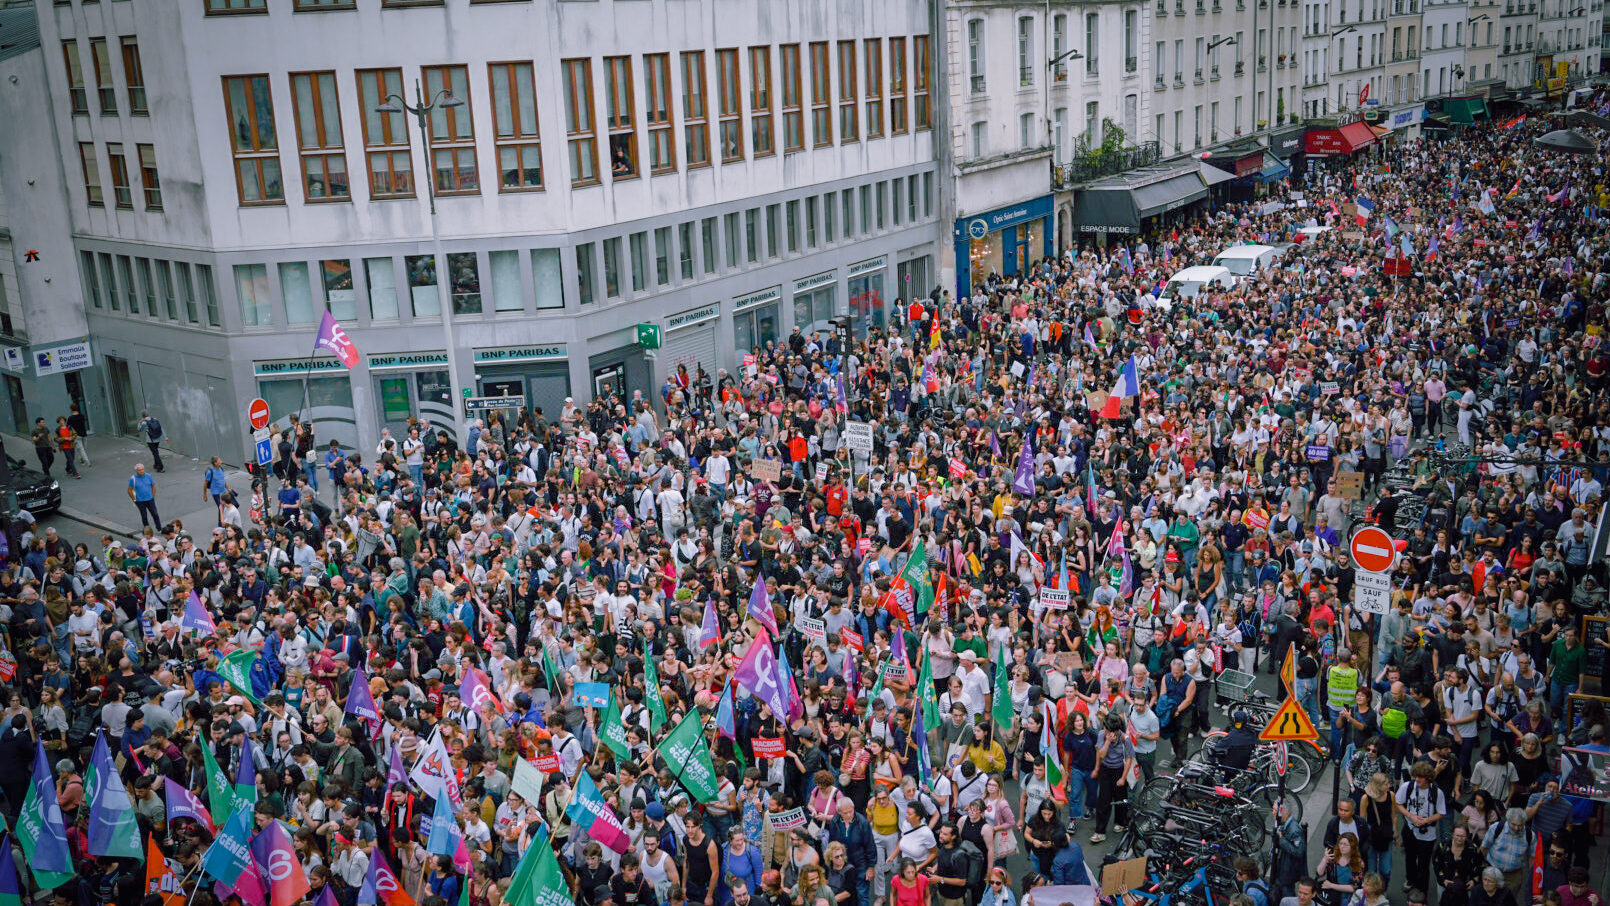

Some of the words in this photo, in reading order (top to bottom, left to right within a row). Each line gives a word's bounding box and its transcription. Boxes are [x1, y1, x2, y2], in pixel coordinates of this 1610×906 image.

[1081, 225, 1107, 233] ESPACE
[850, 265, 861, 273] BNP
[861, 259, 883, 270] PARIBAS
[797, 280, 809, 289] BNP
[809, 273, 833, 285] PARIBAS
[736, 299, 749, 308] BNP
[750, 290, 776, 303] PARIBAS
[669, 316, 684, 326] BNP
[685, 307, 714, 322] PARIBAS
[59, 353, 87, 363] Boutique
[481, 350, 506, 359] BNP
[509, 347, 560, 357] PARIBAS
[60, 360, 88, 370] Solidaire
[371, 356, 396, 366] BNP
[400, 353, 448, 364] PARIBAS
[261, 362, 286, 372] BNP
[289, 360, 341, 371] PARIBAS
[1357, 575, 1374, 584] SAUF
[1375, 578, 1389, 586] BUS
[1363, 588, 1382, 597] SAUF
[678, 747, 710, 779] JEUNES
